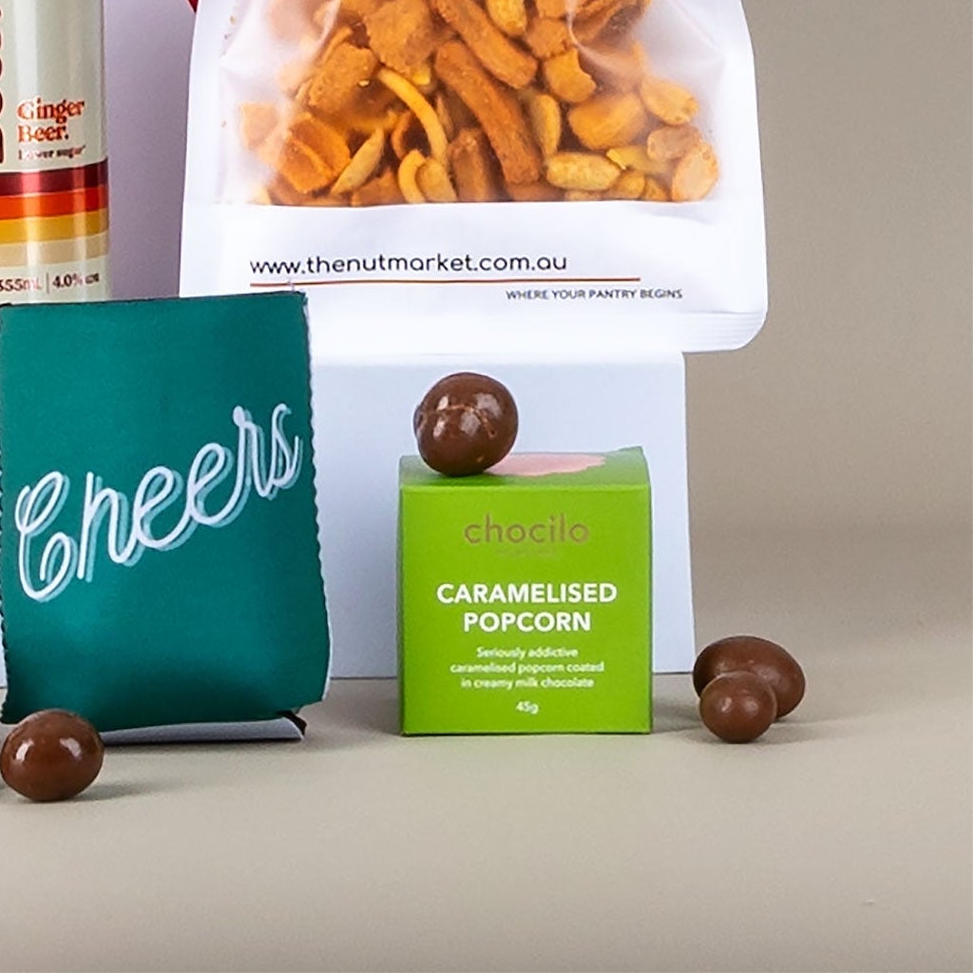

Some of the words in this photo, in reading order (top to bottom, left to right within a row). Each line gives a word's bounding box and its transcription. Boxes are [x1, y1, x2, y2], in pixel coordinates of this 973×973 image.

[17, 97, 85, 124] Ginger
[17, 125, 69, 142] Beer.
[250, 253, 567, 275] www.thenutmarket.com.au
[506, 290, 548, 300] WHERE
[552, 290, 585, 299] YOUR
[588, 289, 636, 299] PANTRY
[640, 289, 683, 299] BEGINS
[15, 403, 303, 603] Cheers
[464, 513, 589, 544] chocilo
[436, 583, 618, 604] CARAMELISED
[463, 612, 591, 632] POPCORN
[476, 646, 526, 660] Seriously
[528, 647, 578, 658] addictive
[450, 661, 516, 673] caramelised
[518, 663, 565, 675] popcorn
[567, 661, 604, 673] coated
[461, 678, 472, 688] in
[474, 679, 513, 690] creamy
[515, 678, 538, 688] milk
[541, 677, 594, 688] chocolate
